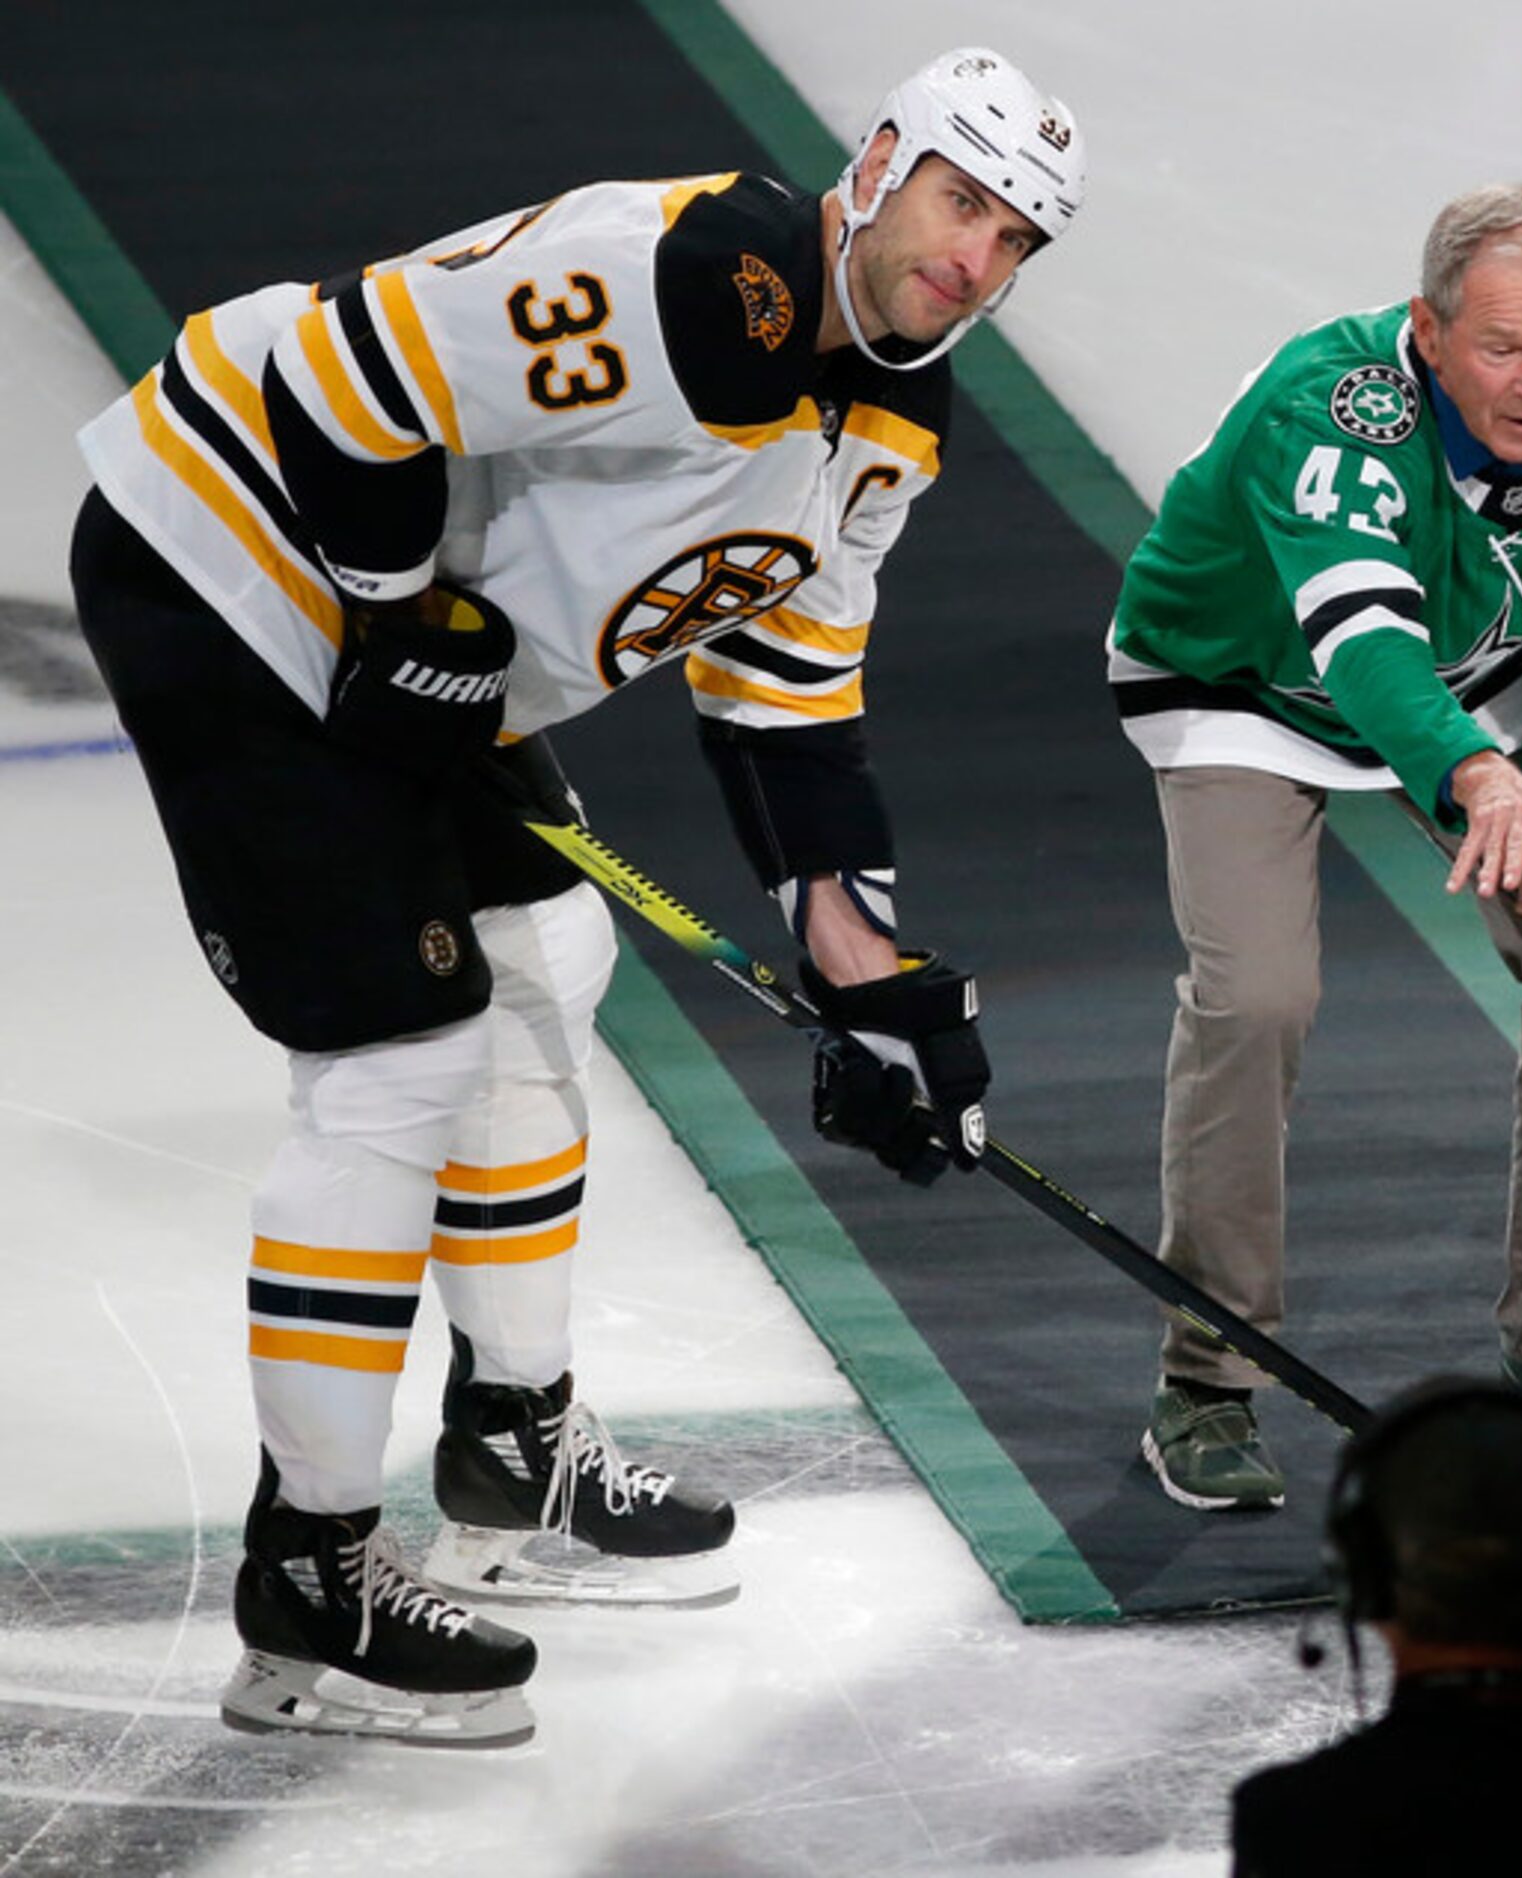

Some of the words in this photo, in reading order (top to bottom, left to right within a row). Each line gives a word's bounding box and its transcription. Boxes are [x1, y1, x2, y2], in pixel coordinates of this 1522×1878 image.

[507, 269, 631, 411] 33
[840, 464, 902, 533] C
[1294, 445, 1407, 544] 43
